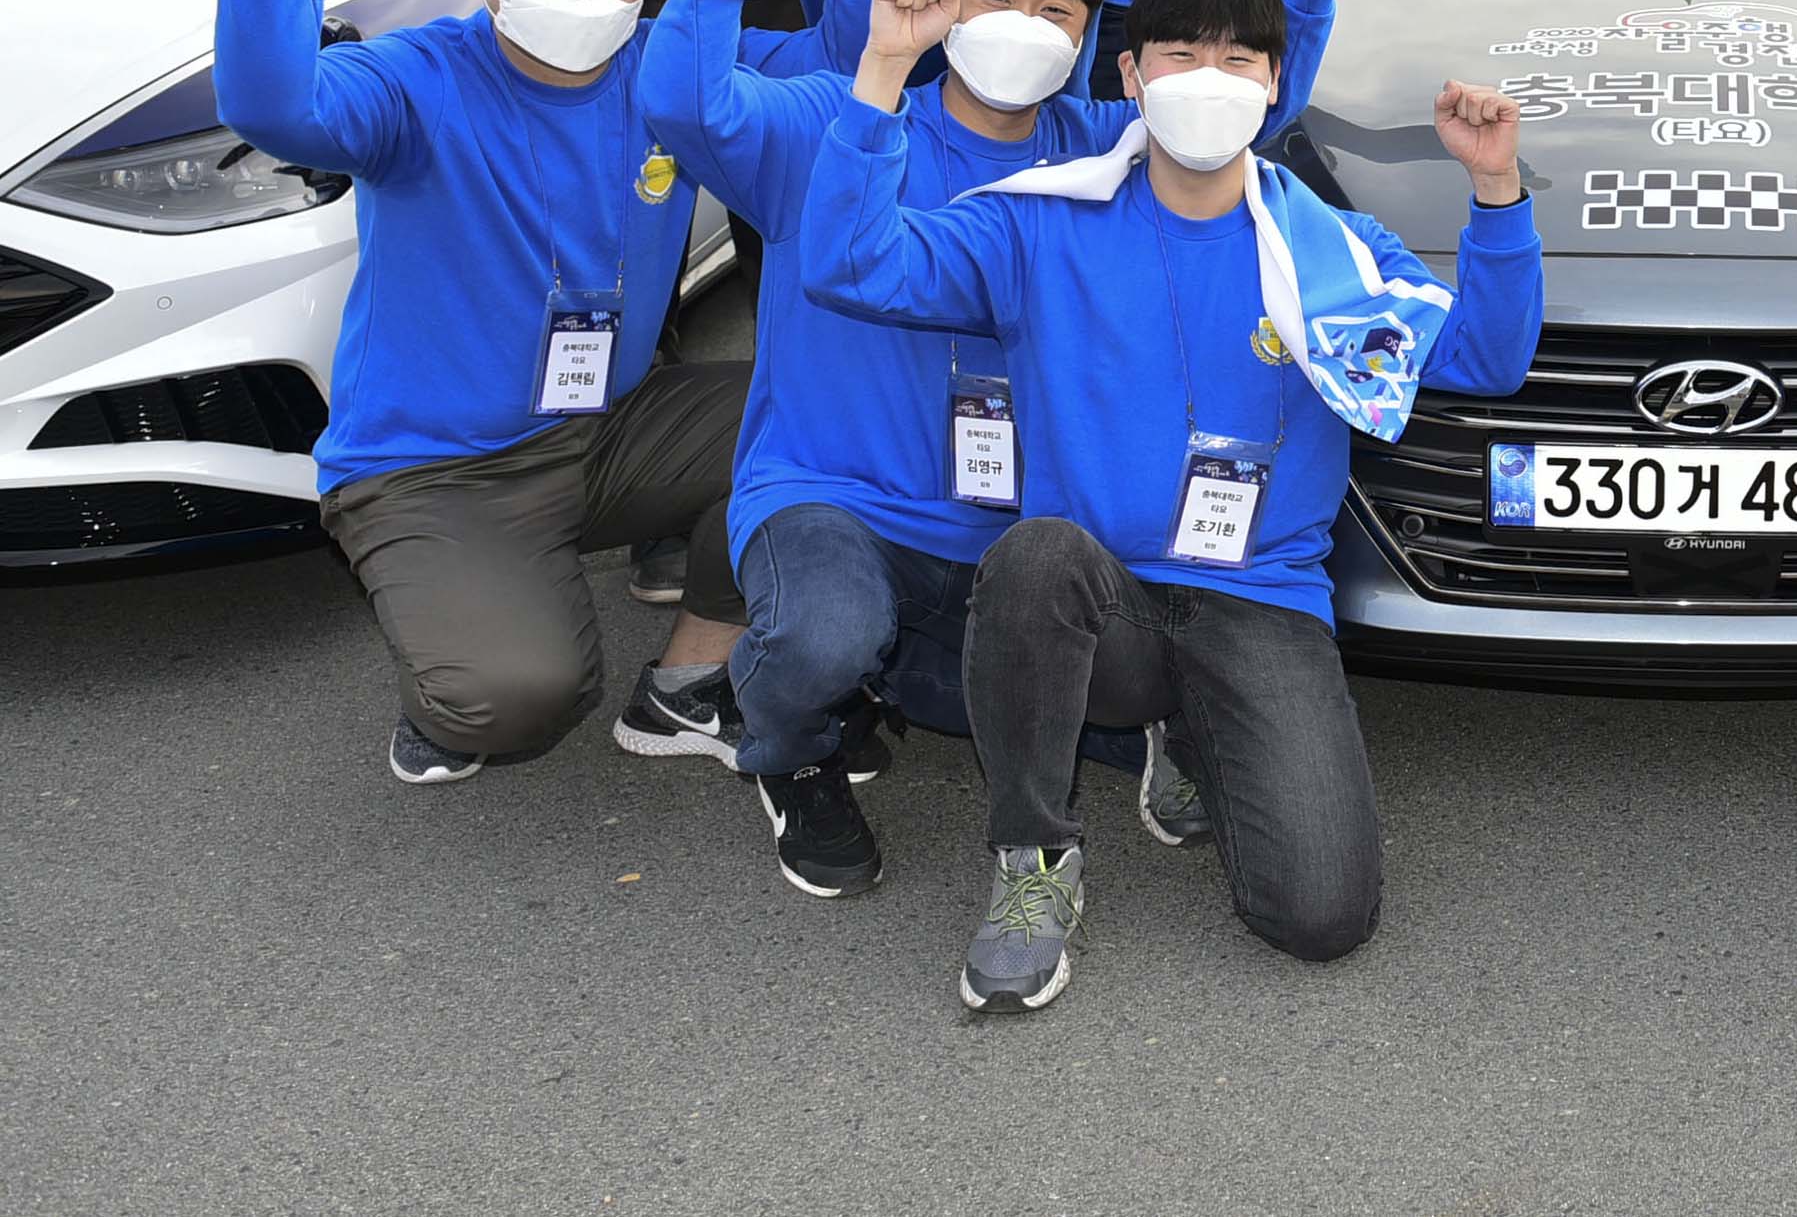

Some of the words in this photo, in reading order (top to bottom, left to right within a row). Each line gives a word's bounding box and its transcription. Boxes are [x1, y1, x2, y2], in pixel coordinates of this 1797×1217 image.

[1532, 28, 1596, 39] 2020
[1604, 17, 1791, 52] 자율주행
[1494, 40, 1594, 56] 대학생
[1655, 119, 1768, 145] (타요)
[966, 459, 1003, 475] 김영규
[1544, 457, 1720, 519] 330거
[1210, 504, 1228, 514] 타요
[1494, 501, 1531, 518] KOR
[1192, 519, 1237, 537] 조기환
[1689, 539, 1746, 550] HYUNDAI
